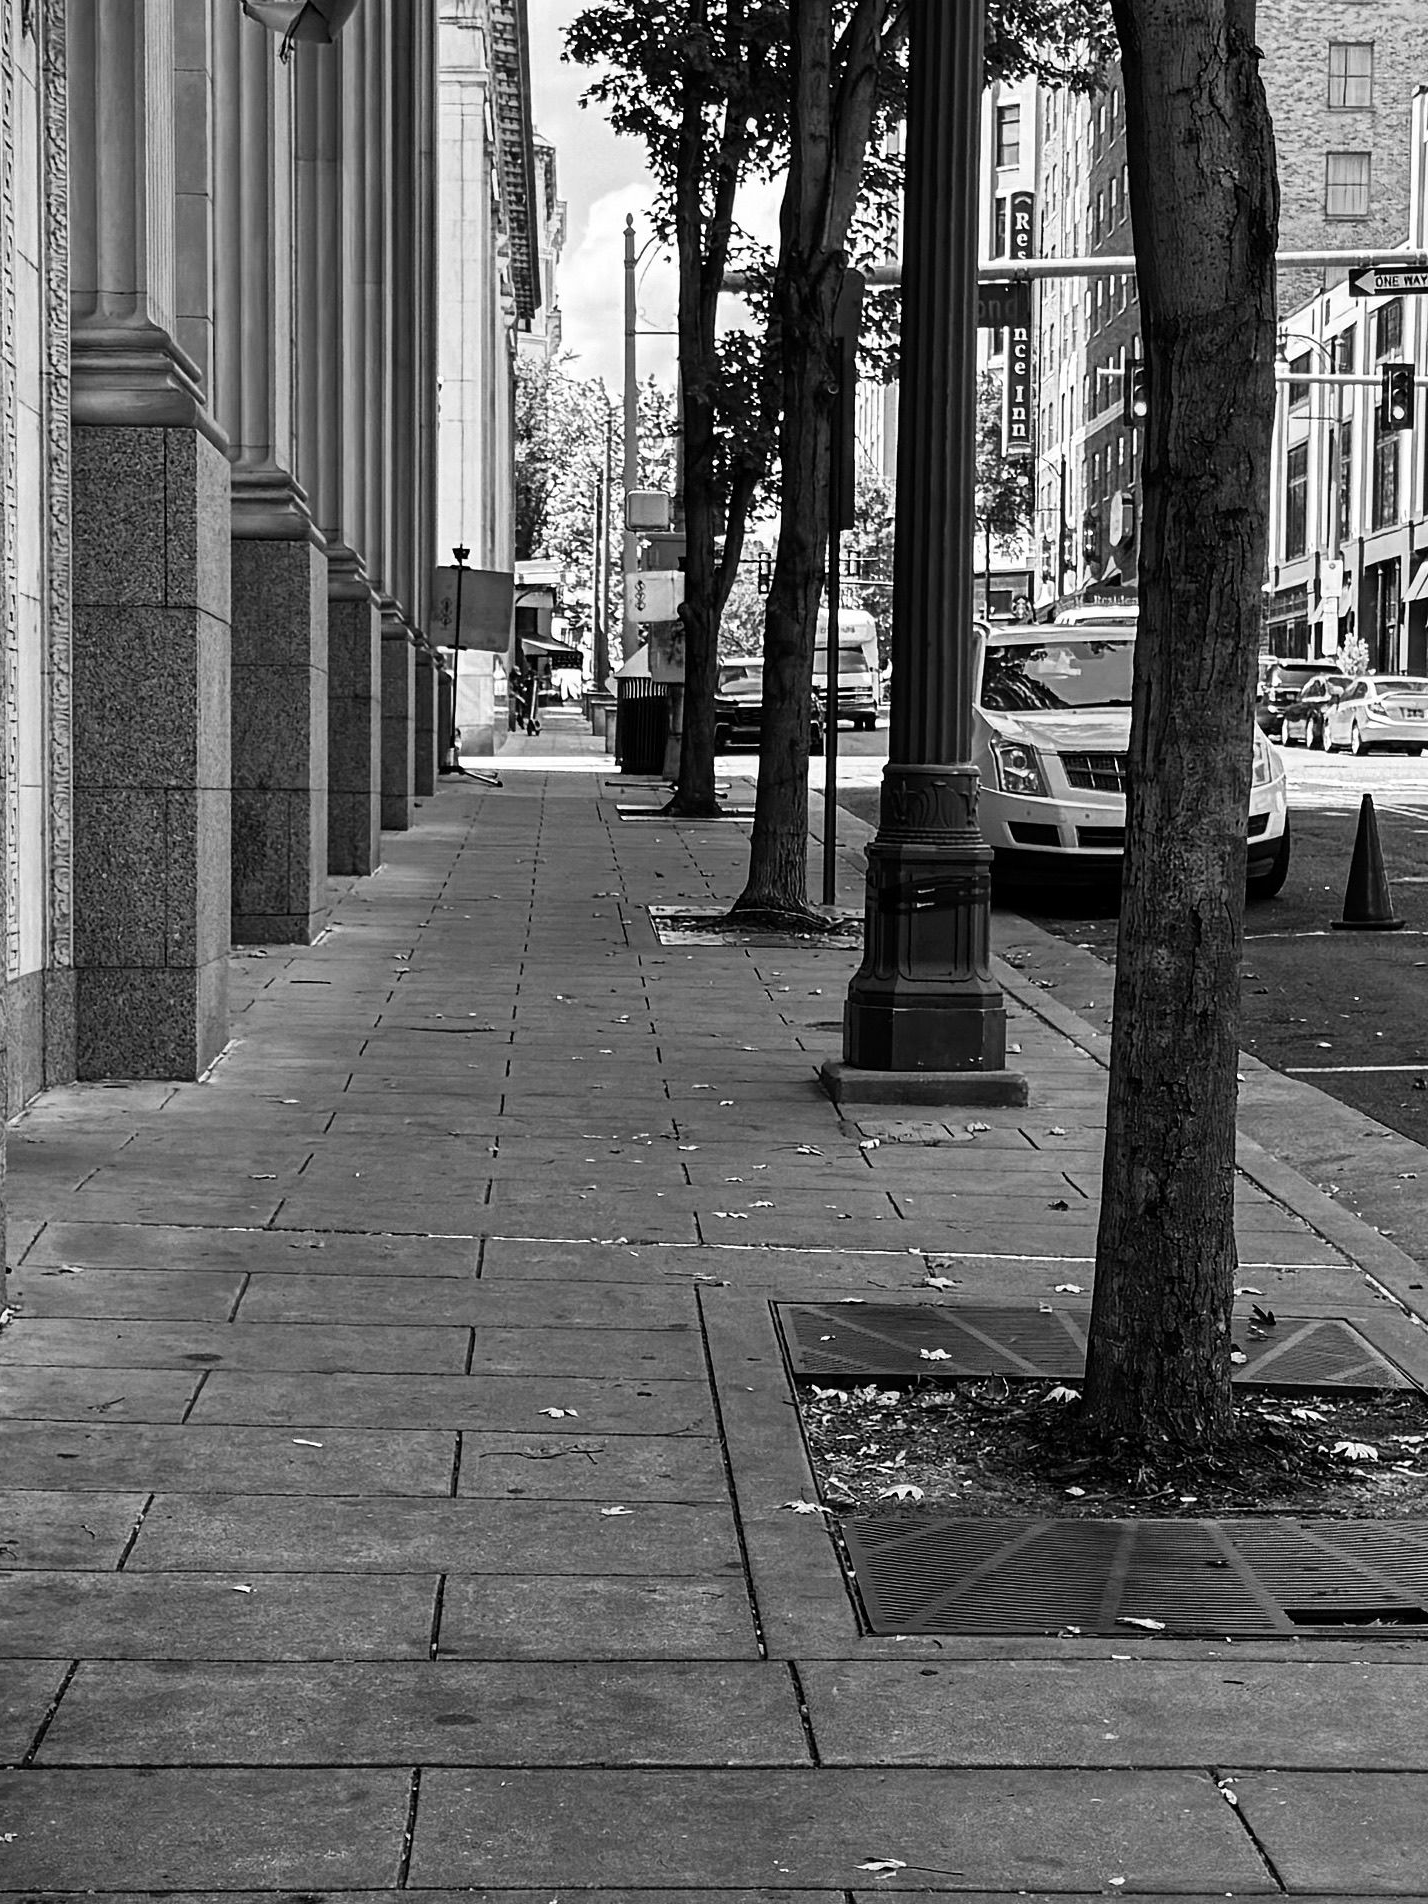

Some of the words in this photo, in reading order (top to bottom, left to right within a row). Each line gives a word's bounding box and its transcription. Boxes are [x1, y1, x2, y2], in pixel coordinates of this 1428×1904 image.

[1014, 212, 1030, 376] Resnce
[1375, 275, 1400, 288] ONE
[1403, 275, 1428, 286] WAY
[1012, 385, 1026, 437] Inn
